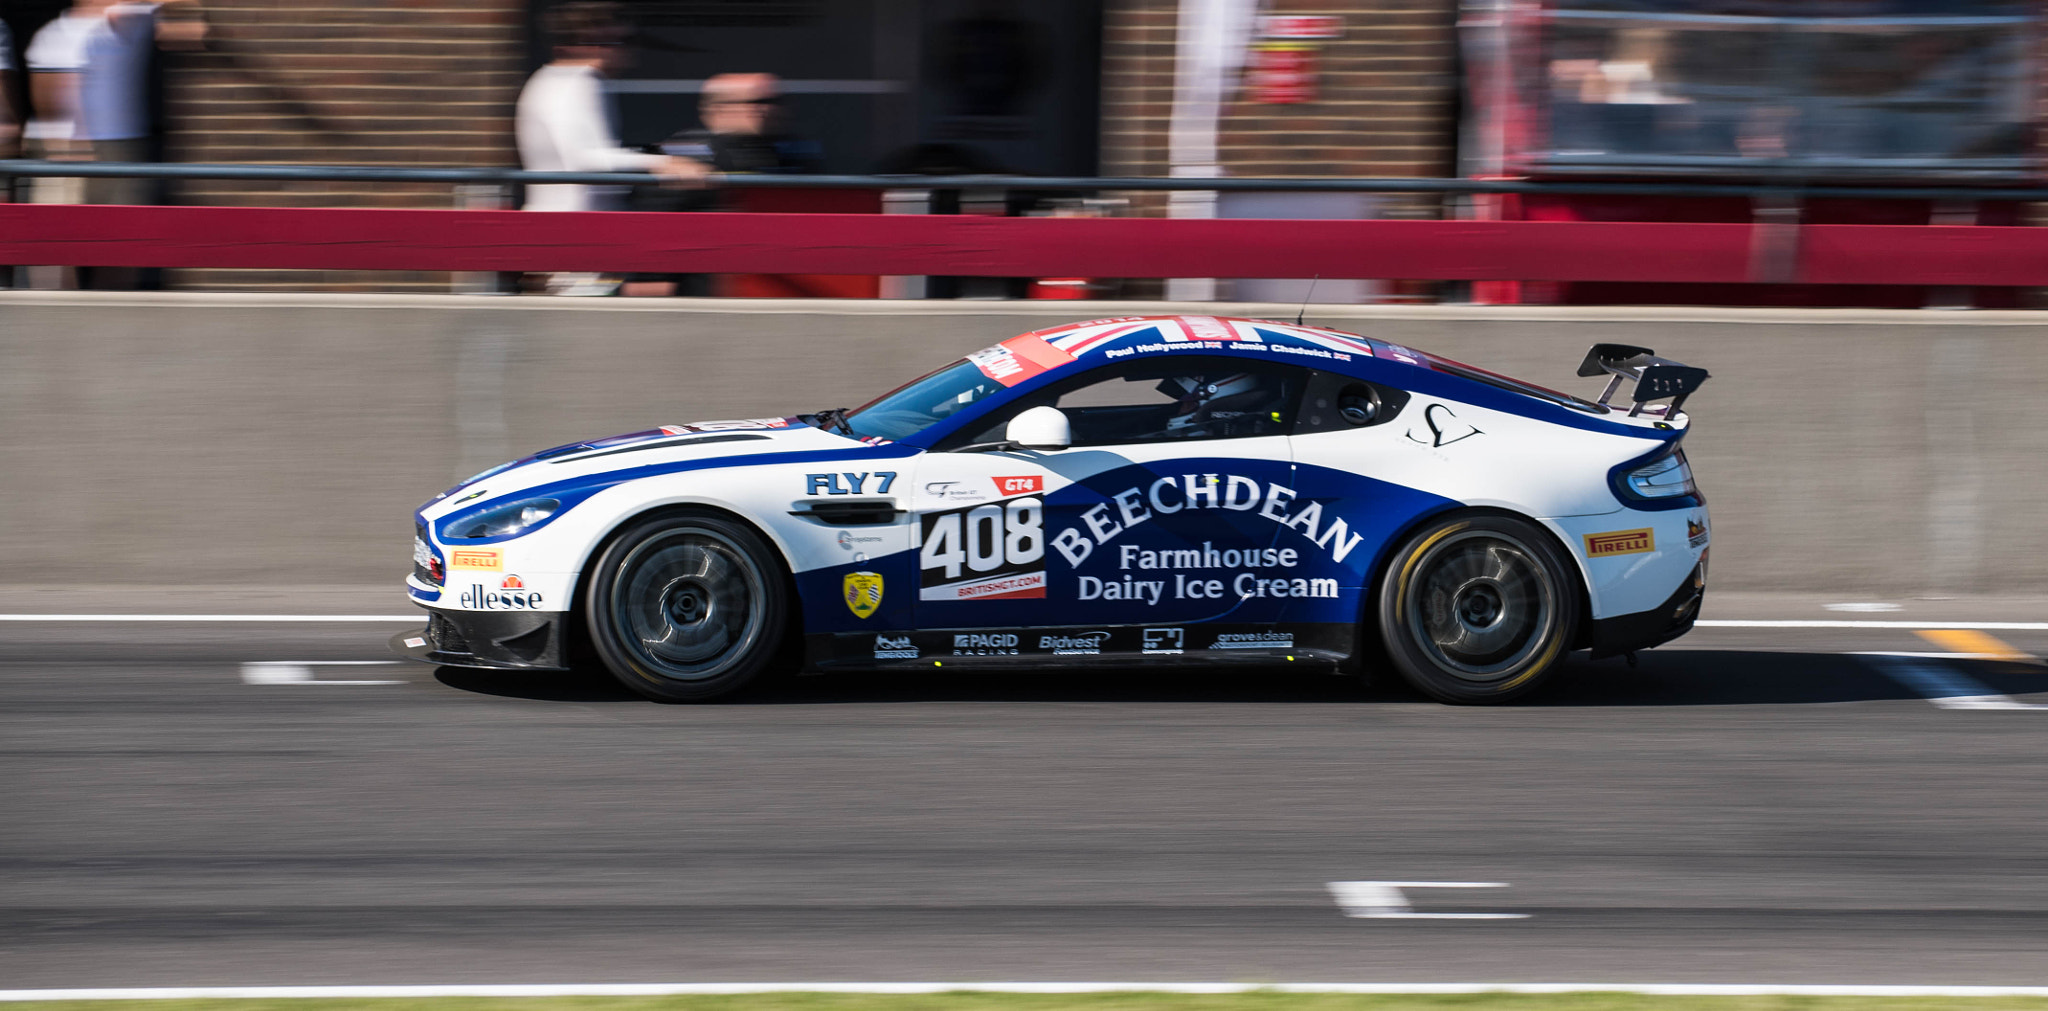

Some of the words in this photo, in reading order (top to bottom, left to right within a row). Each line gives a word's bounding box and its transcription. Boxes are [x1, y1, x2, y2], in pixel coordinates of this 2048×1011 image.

[1105, 346, 1135, 359] Paul
[1136, 341, 1203, 353] Hollywood
[1229, 341, 1268, 351] Jamie
[1271, 344, 1332, 358] Chadwick
[806, 473, 868, 495] FLY
[875, 472, 897, 493] 7
[1004, 478, 1034, 491] GT4
[1050, 473, 1364, 569] BEECHDEAN
[920, 498, 1045, 579] 408
[1589, 532, 1648, 553] PIRELLI
[452, 551, 497, 567] PIRELLI
[1119, 541, 1298, 570] Farmhouse
[461, 584, 543, 609] ellesse
[957, 577, 1042, 597] BRITISHGT.COM
[1077, 575, 1165, 605] Dairy
[1175, 574, 1224, 599] Ice
[1233, 573, 1339, 598] Cream
[970, 634, 1019, 647] PAGID
[1039, 635, 1101, 648] Bidvest
